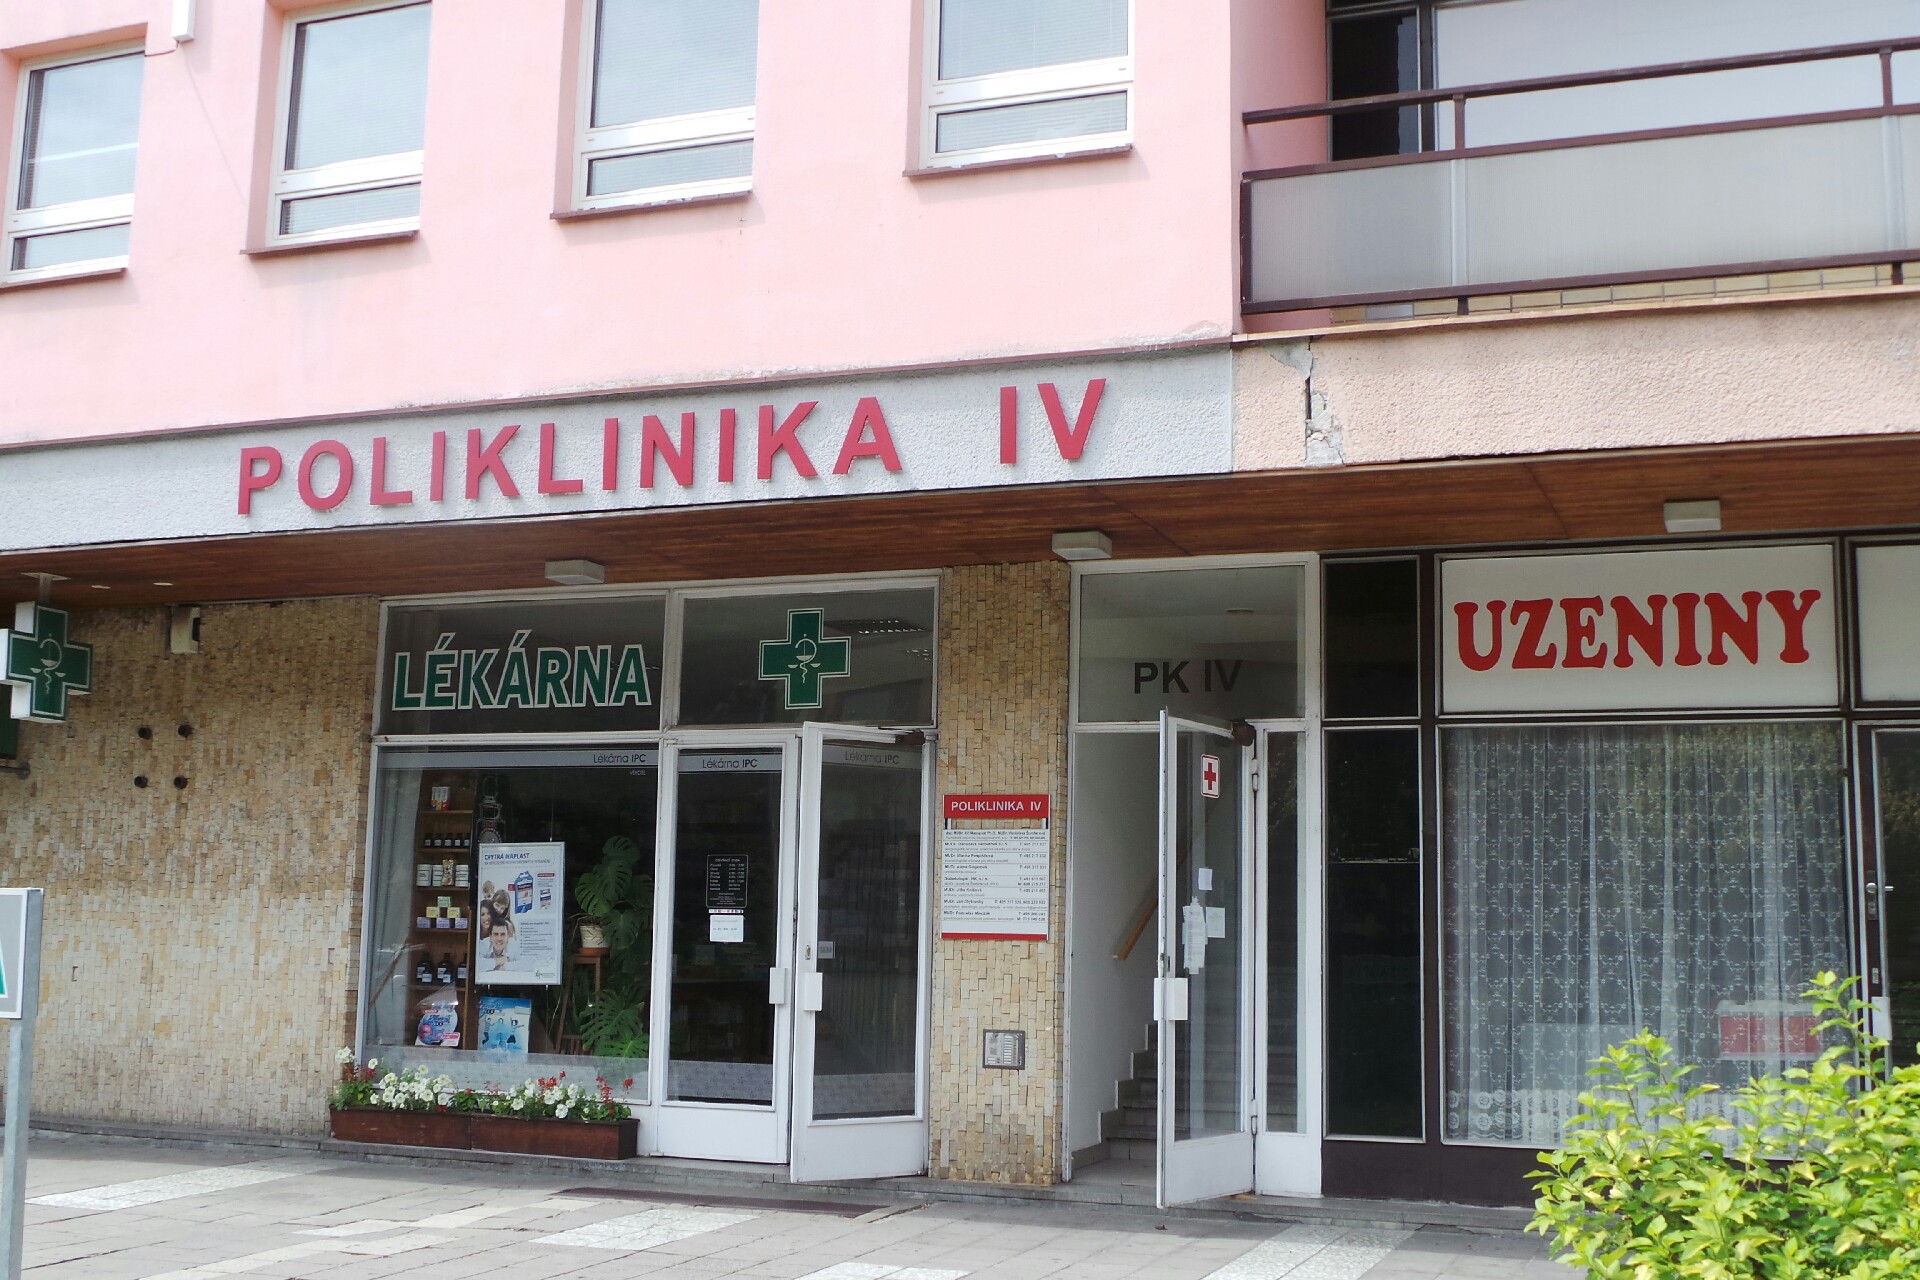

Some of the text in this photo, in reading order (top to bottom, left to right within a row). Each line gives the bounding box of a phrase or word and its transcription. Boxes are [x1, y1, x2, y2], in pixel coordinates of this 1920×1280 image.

[238, 378, 1105, 515] POLIKLINIKA IV
[1455, 590, 1820, 671] UZENINY
[392, 628, 652, 711] LÉKÁRNA
[1134, 659, 1243, 694] PK IV
[593, 752, 647, 763] Lékárna IPC
[702, 758, 758, 769] Lékárna IPC
[845, 750, 900, 765] Lékárna IPC
[951, 801, 1042, 811] POLIKLINIKA IV
